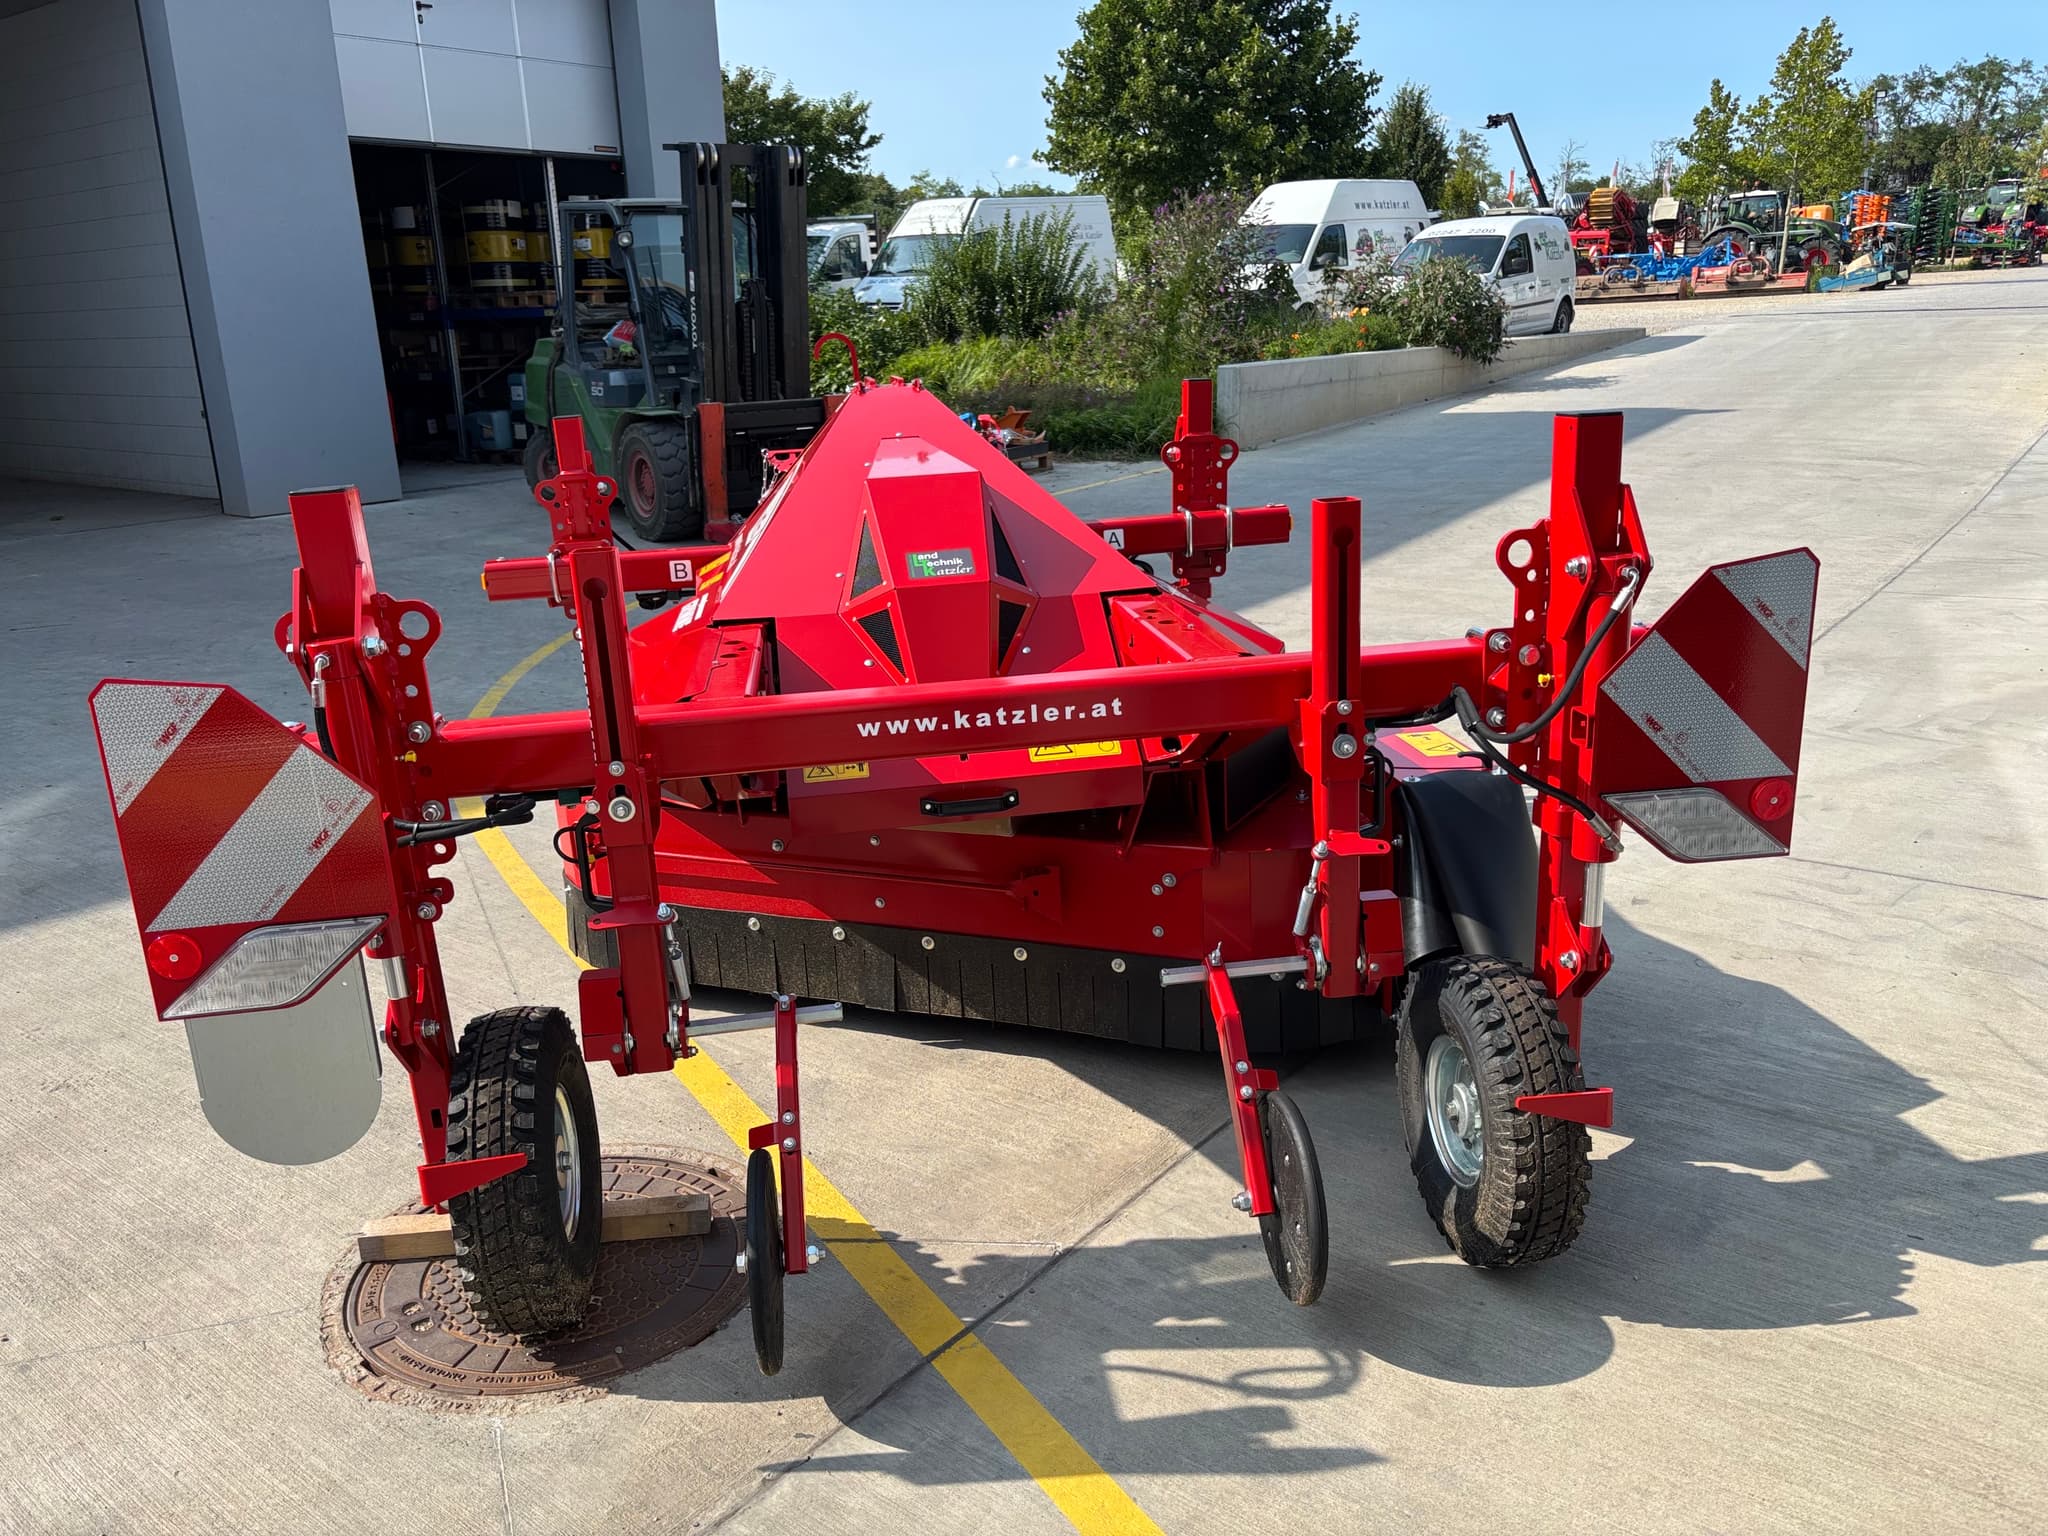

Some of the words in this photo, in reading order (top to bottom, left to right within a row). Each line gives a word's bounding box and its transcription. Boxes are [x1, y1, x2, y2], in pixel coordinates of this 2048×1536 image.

[1354, 200, 1410, 210] www.katzler.at
[689, 296, 698, 349] TOYOTA
[591, 386, 604, 397] 50
[1108, 531, 1122, 548] A
[673, 562, 689, 580] B
[856, 697, 1123, 737] www.katzler.at
